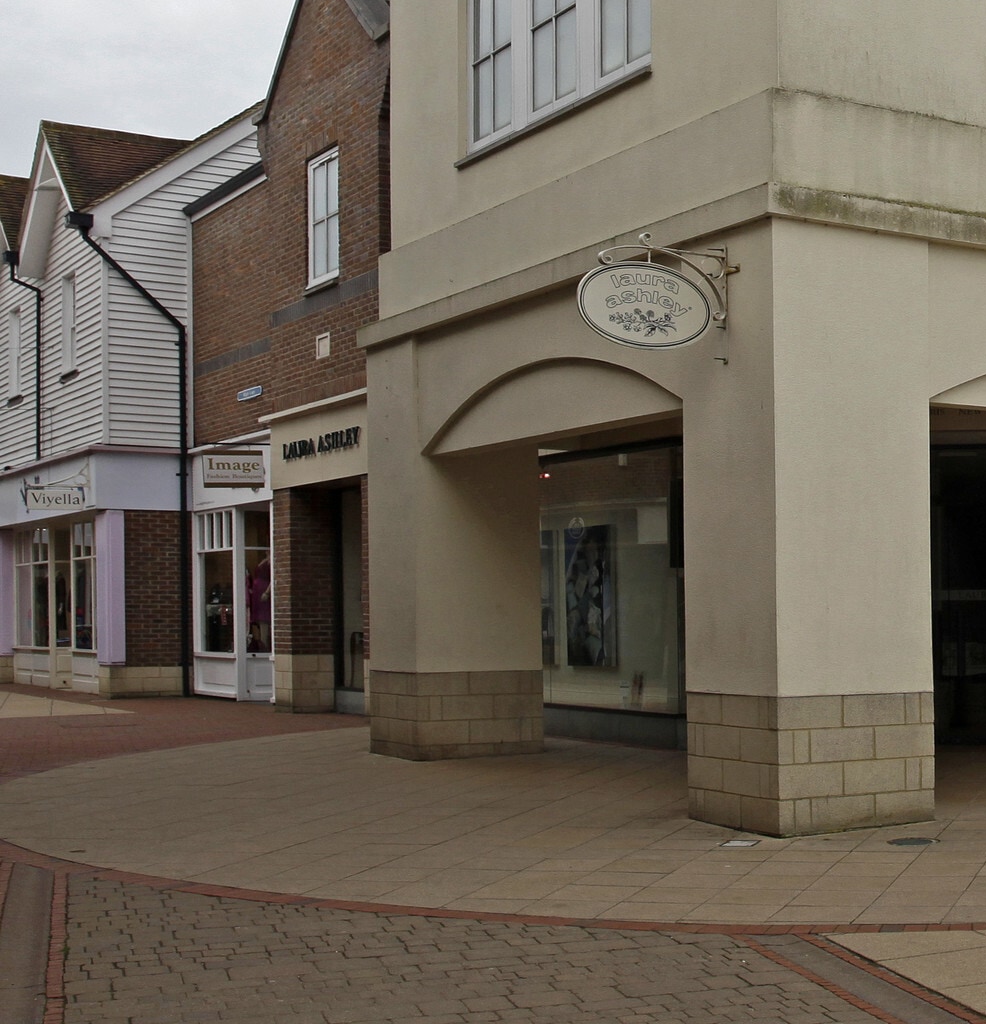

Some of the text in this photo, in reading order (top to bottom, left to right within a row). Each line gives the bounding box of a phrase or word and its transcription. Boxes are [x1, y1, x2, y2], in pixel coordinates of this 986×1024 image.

[610, 273, 680, 294] laura
[605, 288, 688, 317] ashley
[282, 426, 361, 460] LAURA ASHLEY
[207, 458, 260, 474] Image
[31, 493, 80, 507] Viyella
